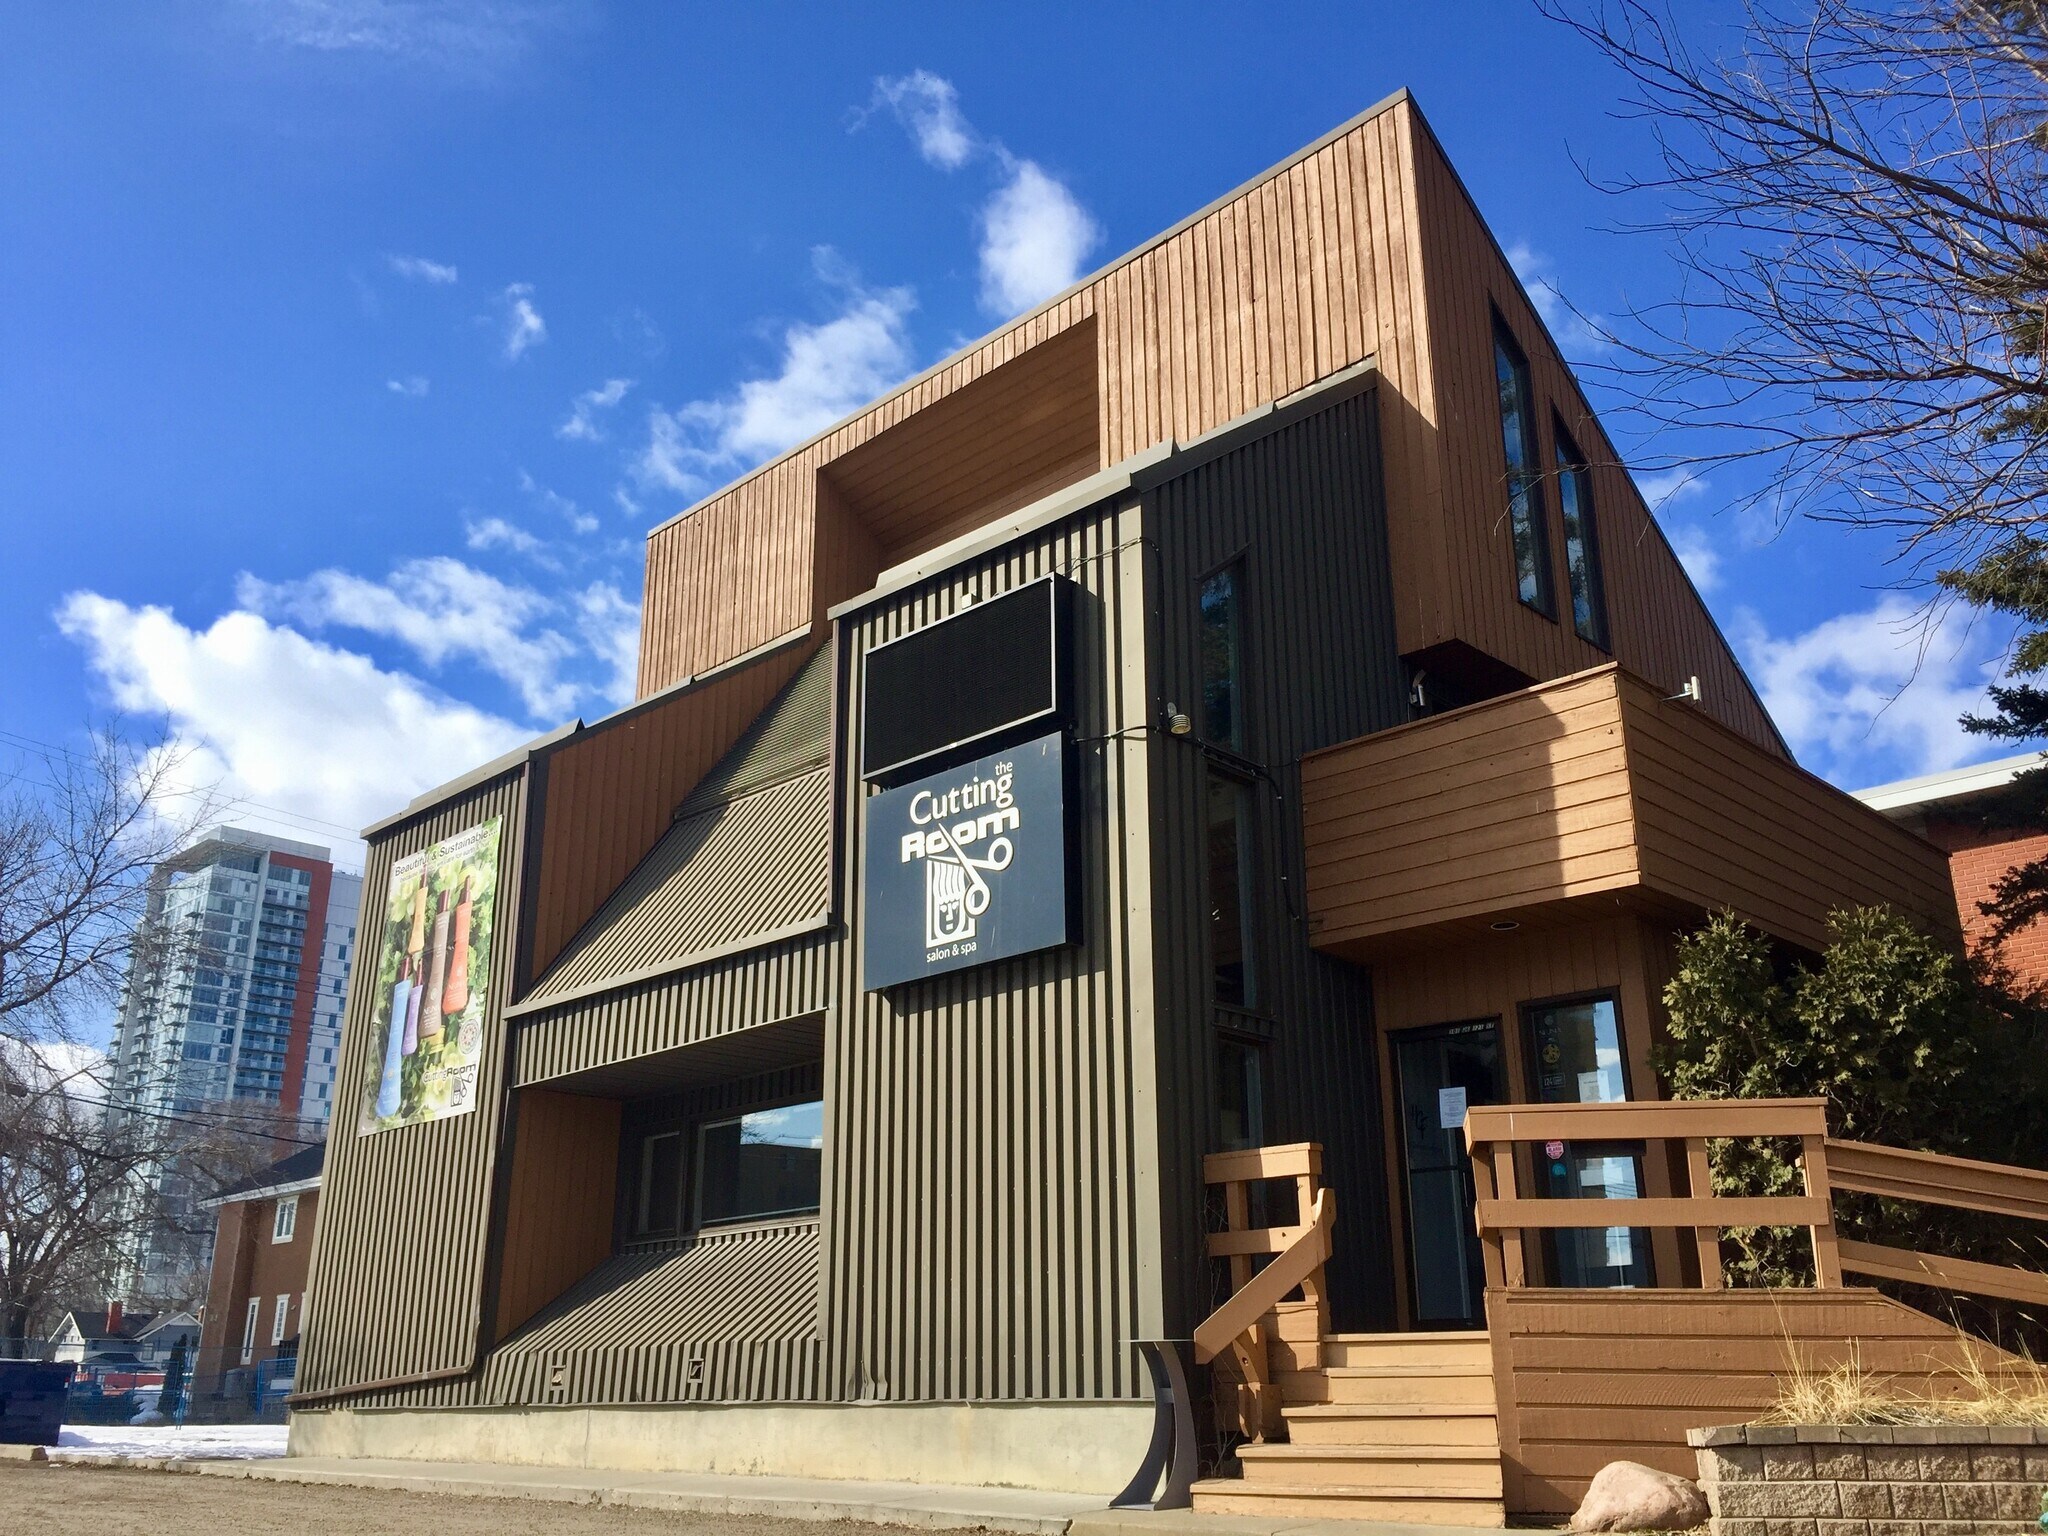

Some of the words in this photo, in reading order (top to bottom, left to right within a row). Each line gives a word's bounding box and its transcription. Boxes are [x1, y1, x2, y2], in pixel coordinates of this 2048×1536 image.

[995, 761, 1013, 776] the
[909, 773, 1014, 825] Cutting
[395, 852, 429, 876] Beautiful
[926, 945, 950, 963] salon
[952, 944, 960, 956] &
[960, 941, 977, 956] spa
